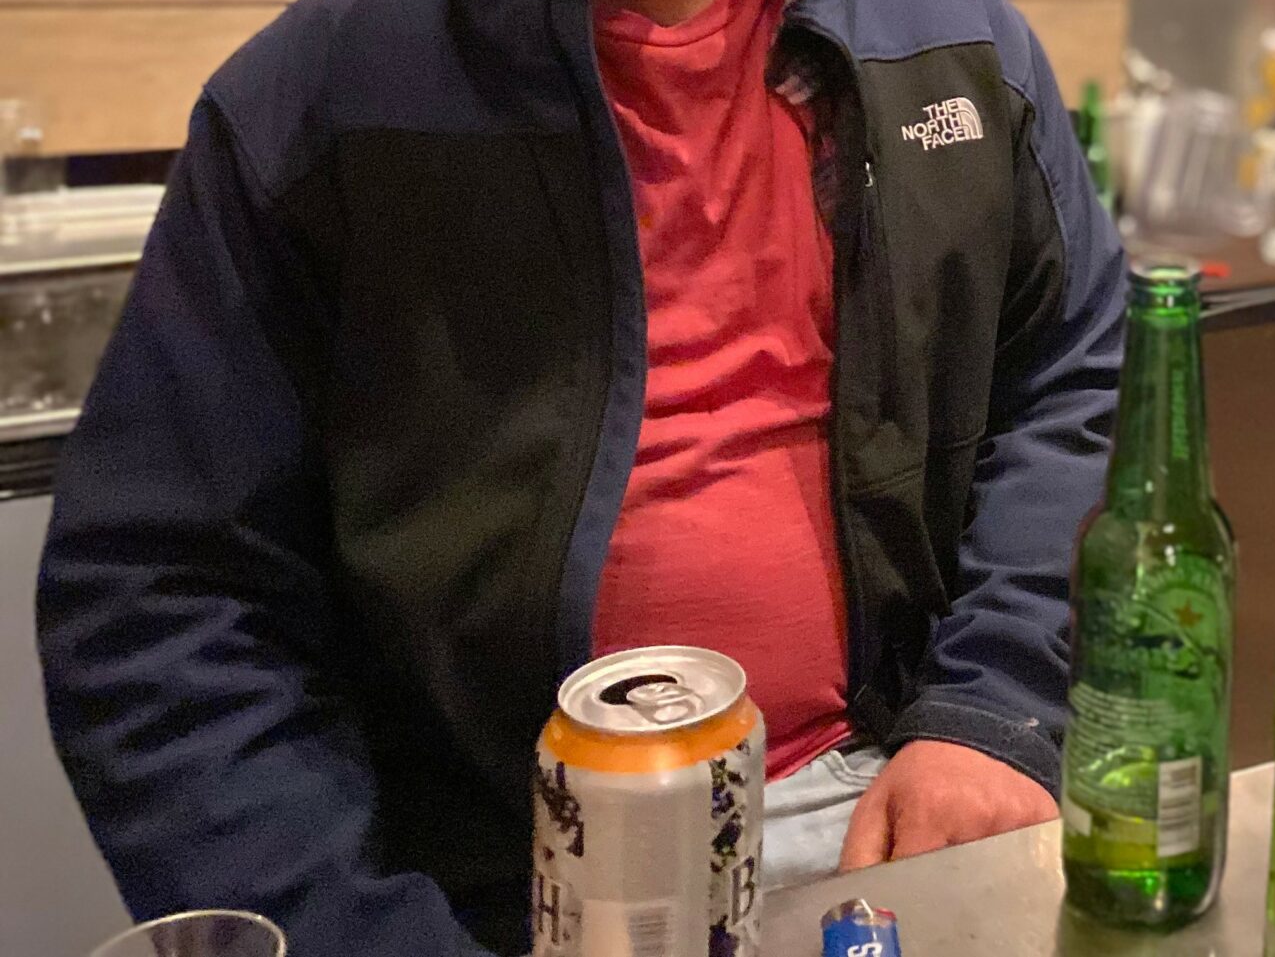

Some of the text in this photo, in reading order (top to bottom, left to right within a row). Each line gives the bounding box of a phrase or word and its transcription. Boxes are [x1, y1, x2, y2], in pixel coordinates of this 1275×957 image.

[922, 99, 959, 120] THE
[901, 112, 962, 141] NORTH
[922, 126, 966, 151] FACE
